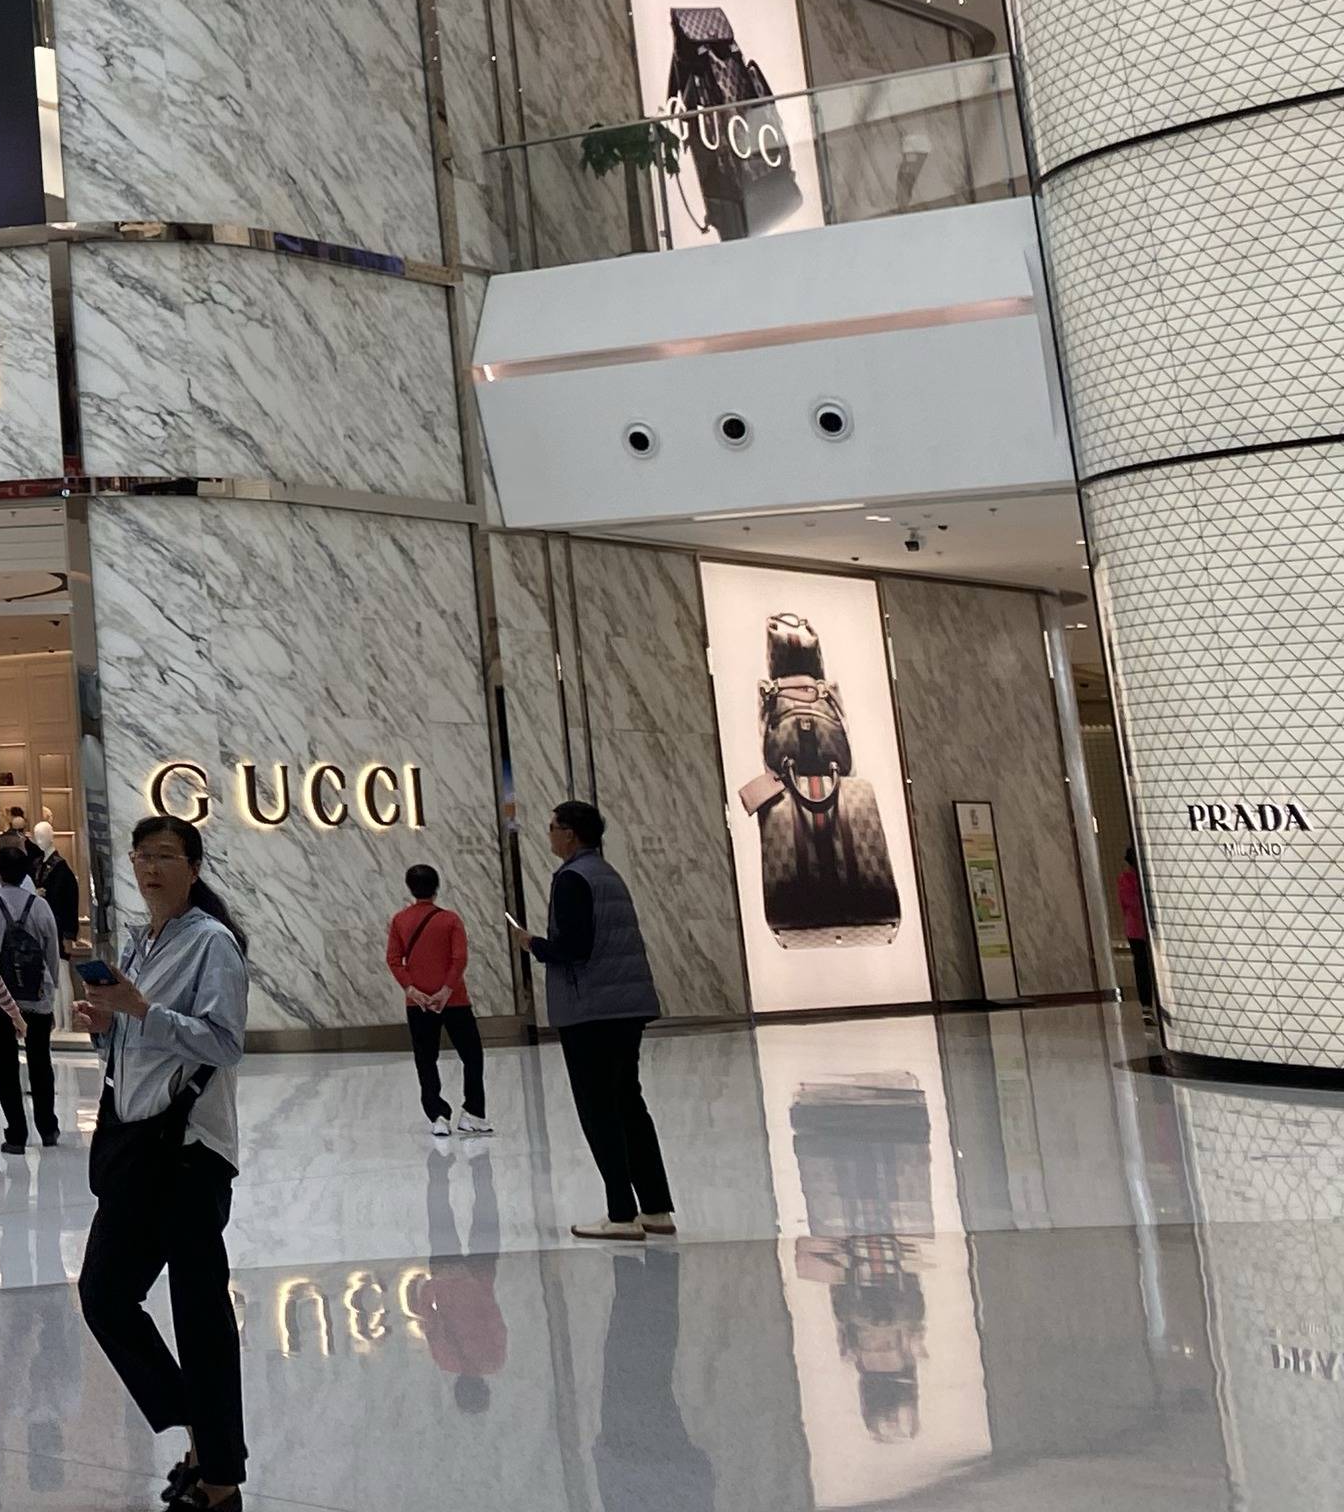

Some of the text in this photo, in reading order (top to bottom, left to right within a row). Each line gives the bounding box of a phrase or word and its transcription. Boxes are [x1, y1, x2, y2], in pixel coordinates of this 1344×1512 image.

[147, 762, 427, 828] GUCCI
[1187, 803, 1311, 832] PRADA
[1223, 842, 1282, 857] MILANO
